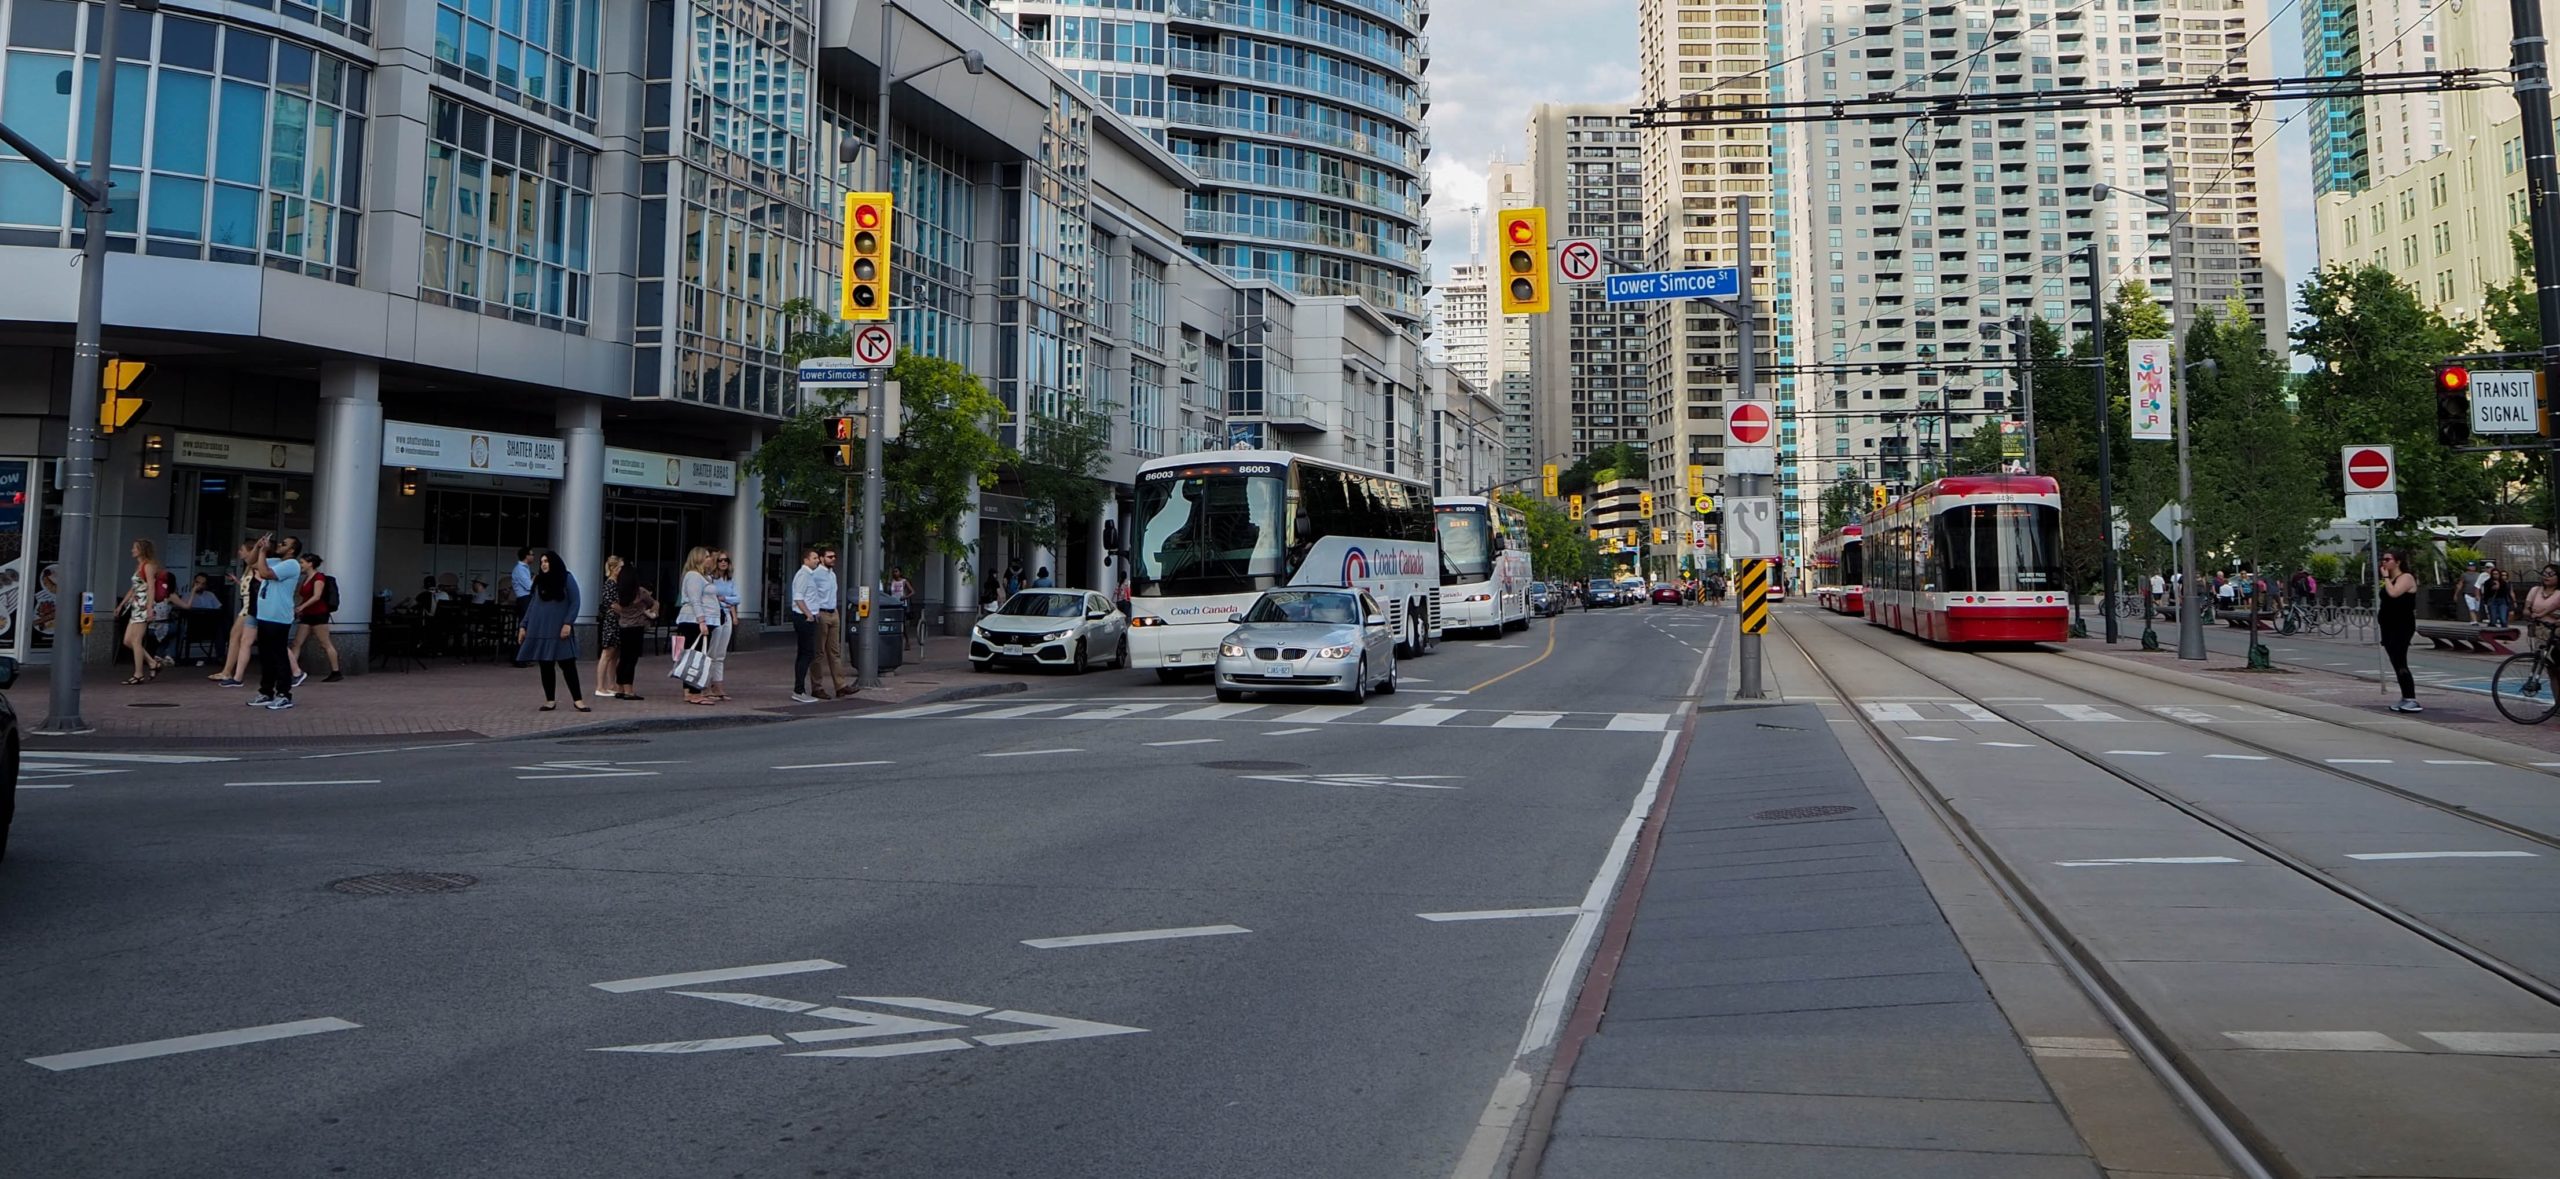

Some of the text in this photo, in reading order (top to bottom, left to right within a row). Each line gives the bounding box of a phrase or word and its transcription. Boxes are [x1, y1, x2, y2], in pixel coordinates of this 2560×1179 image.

[1612, 271, 1728, 295] Lower Simcoe St
[802, 370, 825, 380] Lower
[827, 370, 857, 380] Simcoe
[2476, 381, 2529, 398] TRANSIT
[2481, 406, 2529, 422] SIGNAL
[507, 440, 555, 461] SHATTER ABBAS
[1145, 470, 1174, 481] 86003
[1239, 466, 1271, 474] 86003
[1374, 547, 1424, 576] Coach Canada
[1171, 605, 1238, 616] Coach Canada
